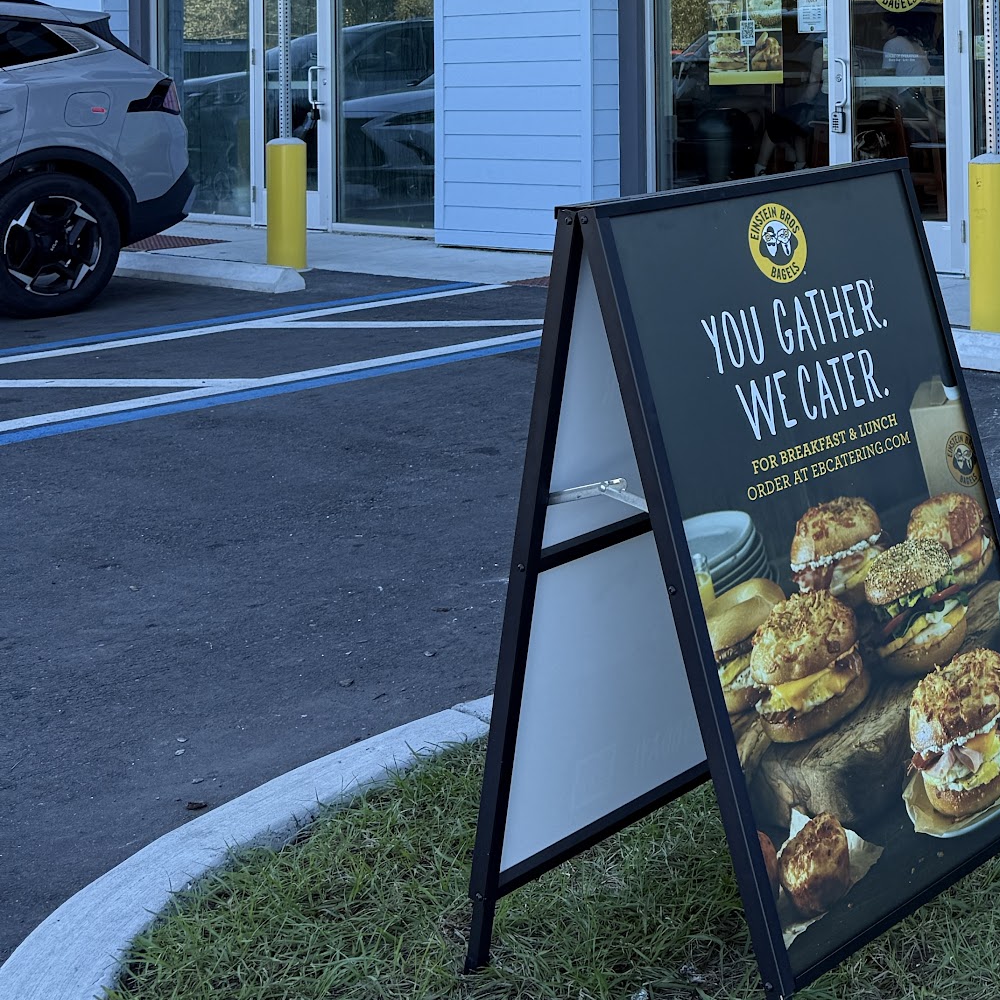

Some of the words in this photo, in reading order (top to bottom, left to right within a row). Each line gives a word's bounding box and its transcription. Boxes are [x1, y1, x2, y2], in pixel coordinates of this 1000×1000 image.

[750, 206, 778, 241] EINSTEIN
[779, 208, 800, 234] BROS
[770, 261, 800, 281] BAGELS
[701, 306, 765, 374] YOU
[772, 279, 888, 355] GATHER.
[735, 369, 798, 442] WE
[797, 349, 890, 421] CATER.
[747, 474, 792, 501] ORDER
[793, 466, 809, 485] AT
[811, 431, 911, 479] EBCATERING.COM
[752, 454, 779, 474] FOR
[779, 430, 847, 466] BREAKFAST
[849, 427, 858, 441] &
[858, 413, 898, 438] LUNCH
